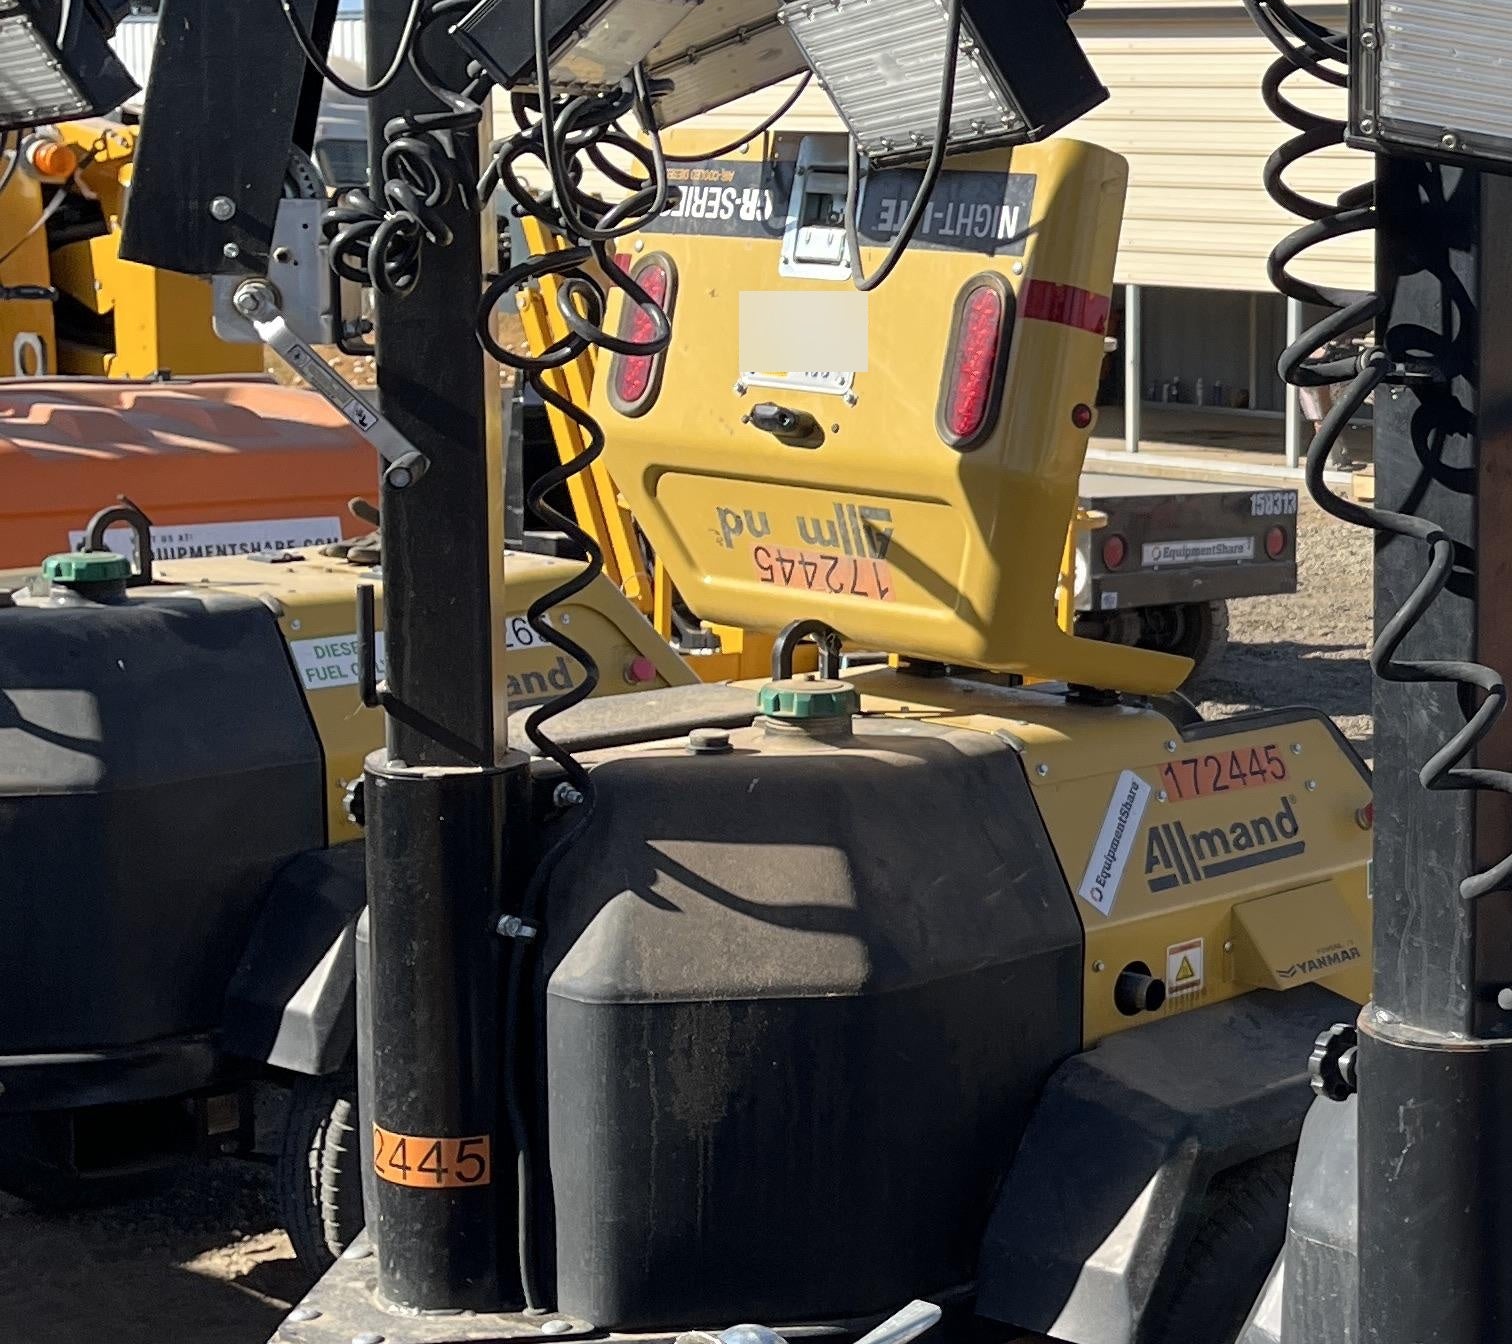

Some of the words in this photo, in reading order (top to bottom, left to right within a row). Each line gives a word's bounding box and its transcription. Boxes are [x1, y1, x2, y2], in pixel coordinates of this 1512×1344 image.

[666, 166, 691, 181] DIESE
[659, 184, 773, 222] GR-SERIE
[879, 197, 1021, 240] NIGHT-LTE
[1162, 543, 1244, 559] EquipmentShare
[753, 545, 889, 600] 172445
[313, 641, 362, 659] DIESE
[305, 664, 349, 683] FUEL
[1164, 744, 1286, 799] 172445
[1096, 780, 1140, 888] EquipmentShare
[1145, 796, 1299, 884] Allmand
[1298, 946, 1361, 974] YANMAR
